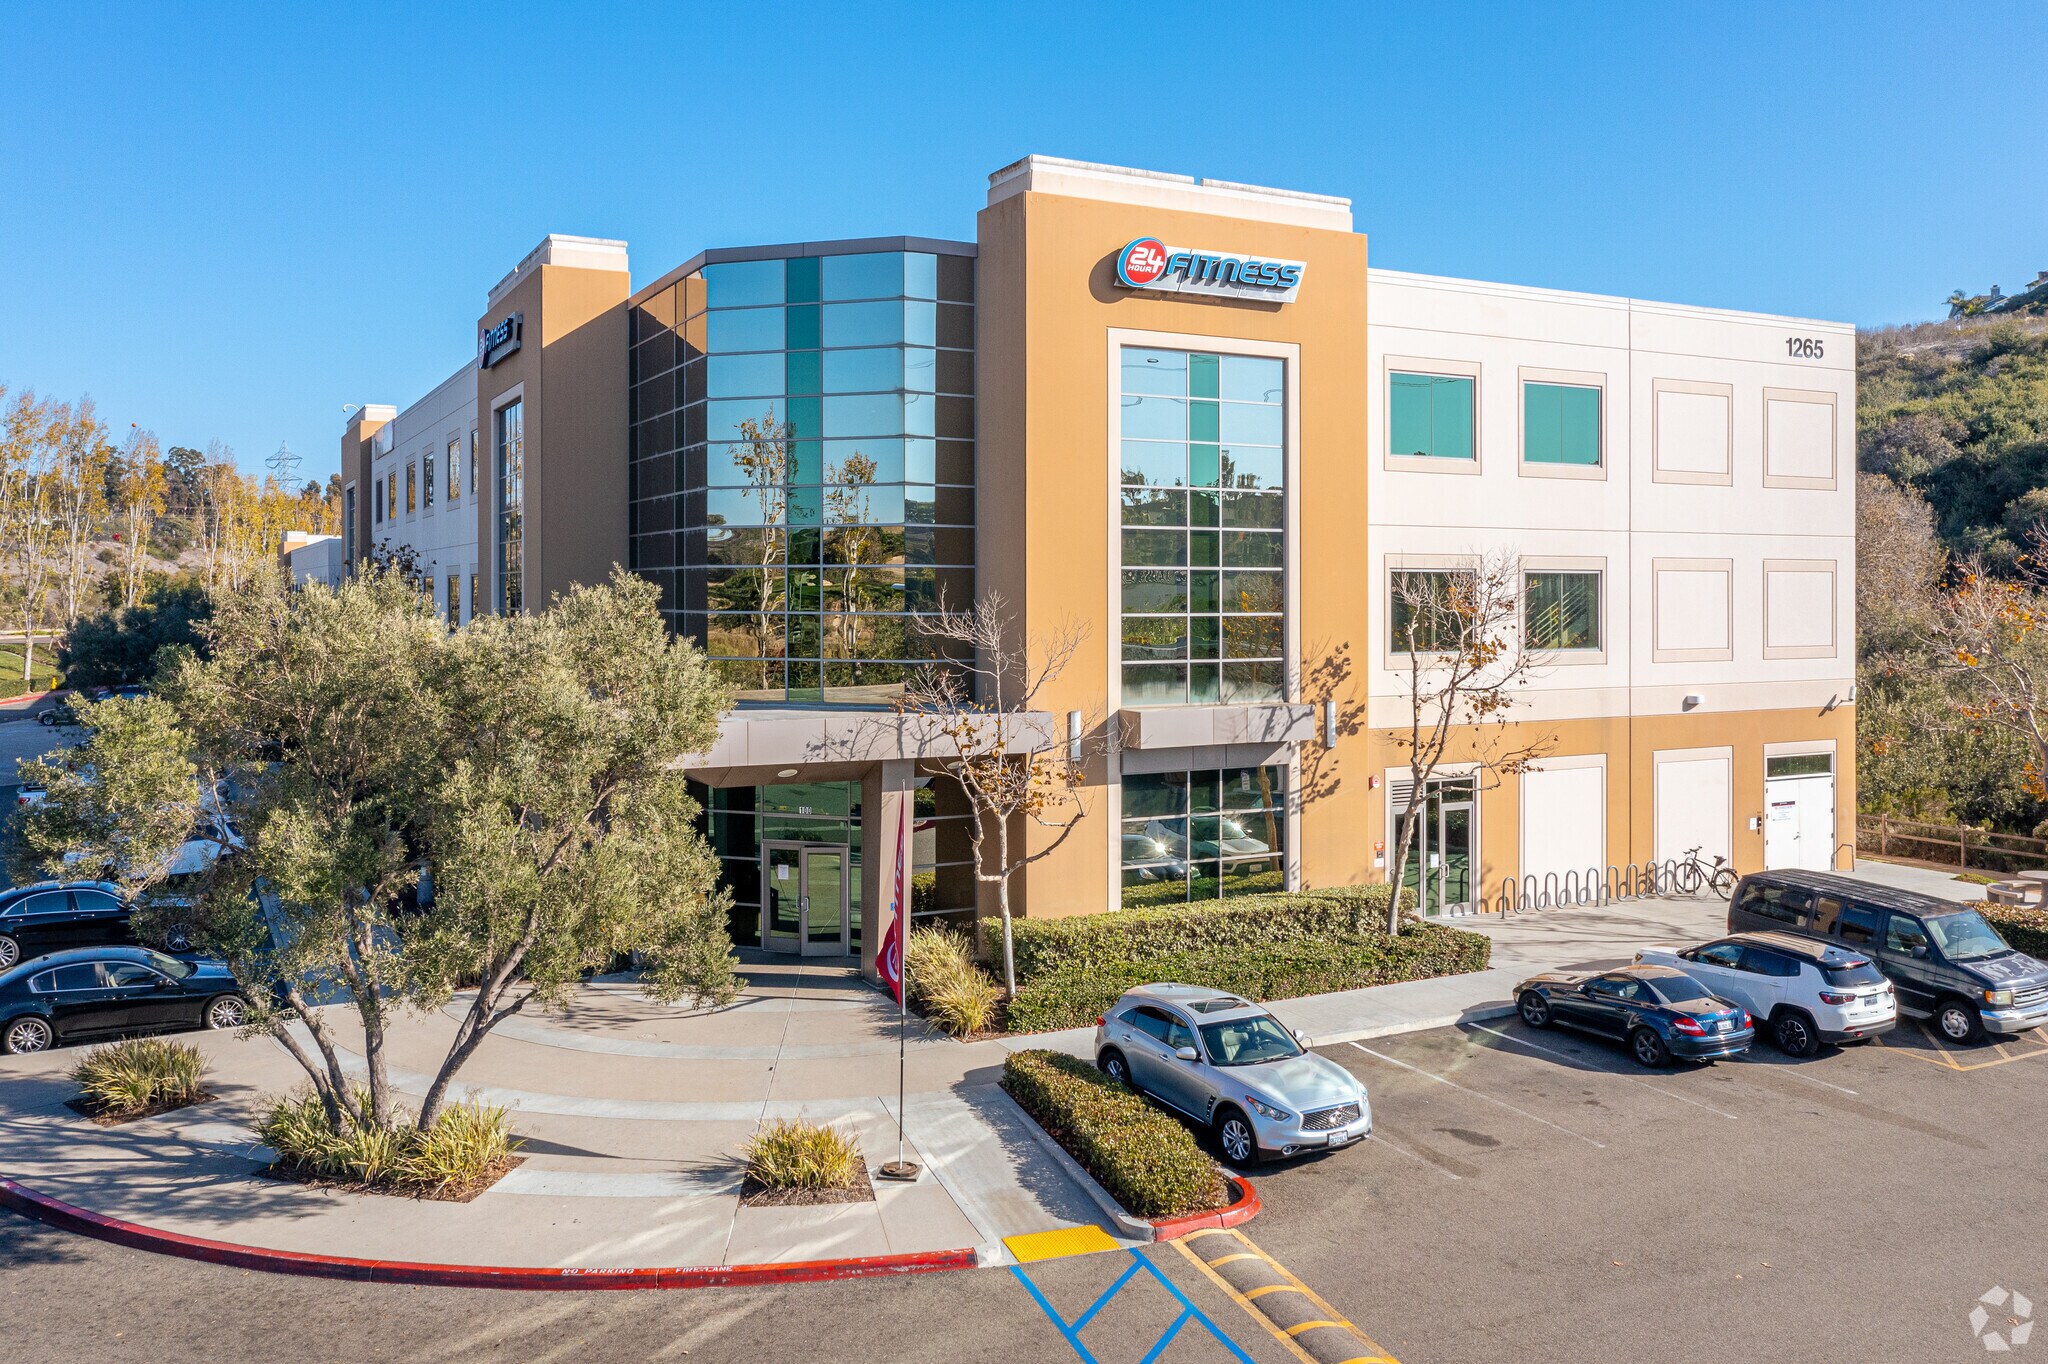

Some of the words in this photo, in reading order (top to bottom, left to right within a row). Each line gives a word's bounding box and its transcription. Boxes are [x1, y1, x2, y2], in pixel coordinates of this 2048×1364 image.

[1127, 264, 1152, 273] HOUR
[1130, 247, 1164, 273] 24
[1167, 252, 1302, 287] FITNESS
[1785, 337, 1824, 359] 1265
